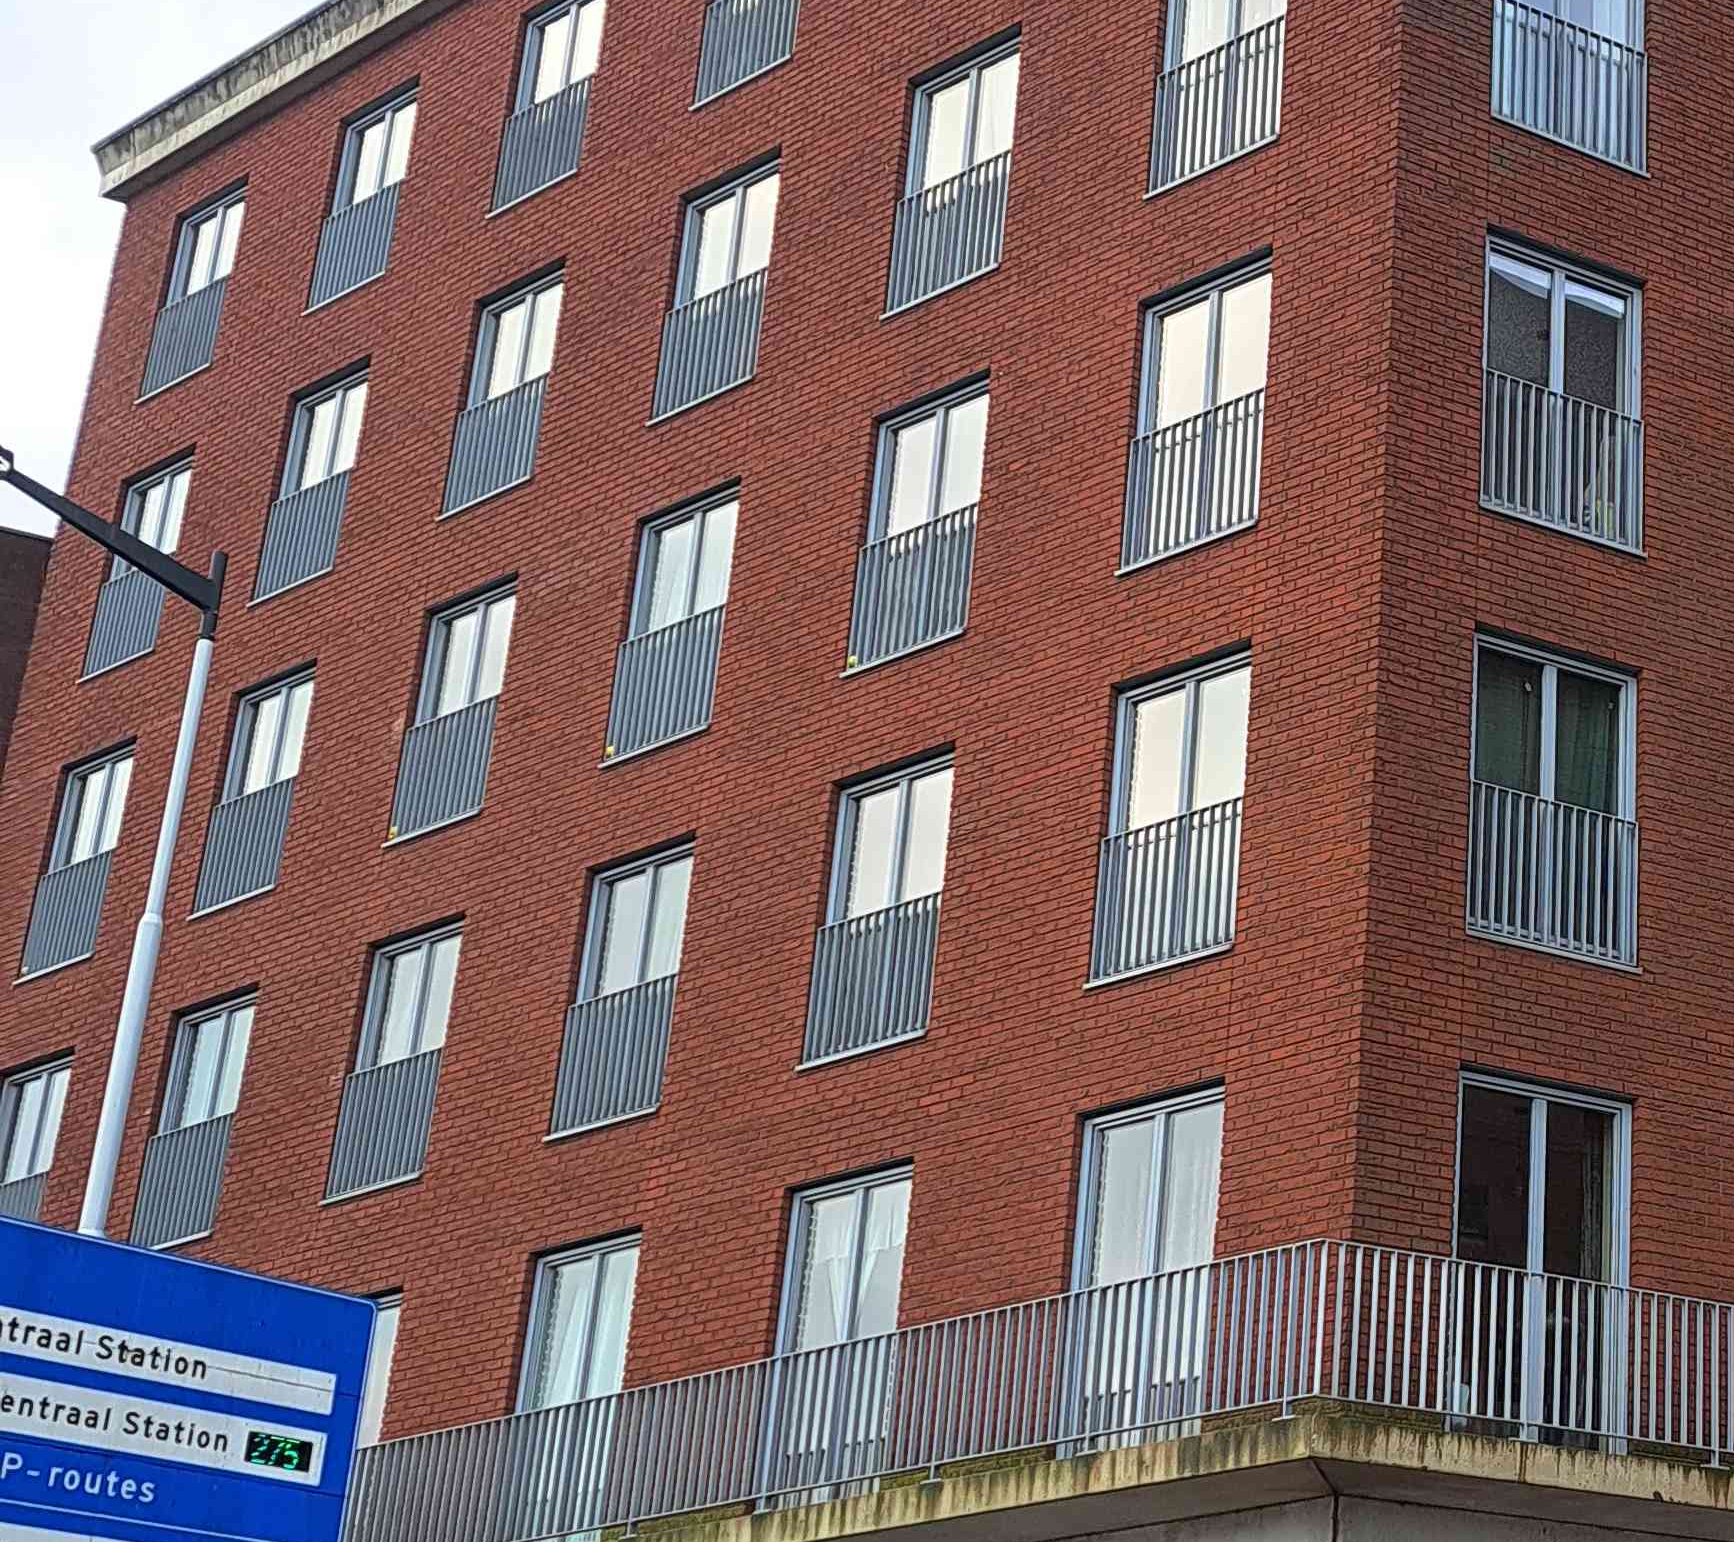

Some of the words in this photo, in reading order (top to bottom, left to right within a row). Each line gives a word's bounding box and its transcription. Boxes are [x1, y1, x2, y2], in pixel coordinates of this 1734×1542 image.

[0, 1317, 84, 1355] traal
[95, 1335, 208, 1380] Station
[0, 1394, 112, 1431] entraal
[122, 1412, 229, 1452] Station
[251, 1434, 300, 1469] 275
